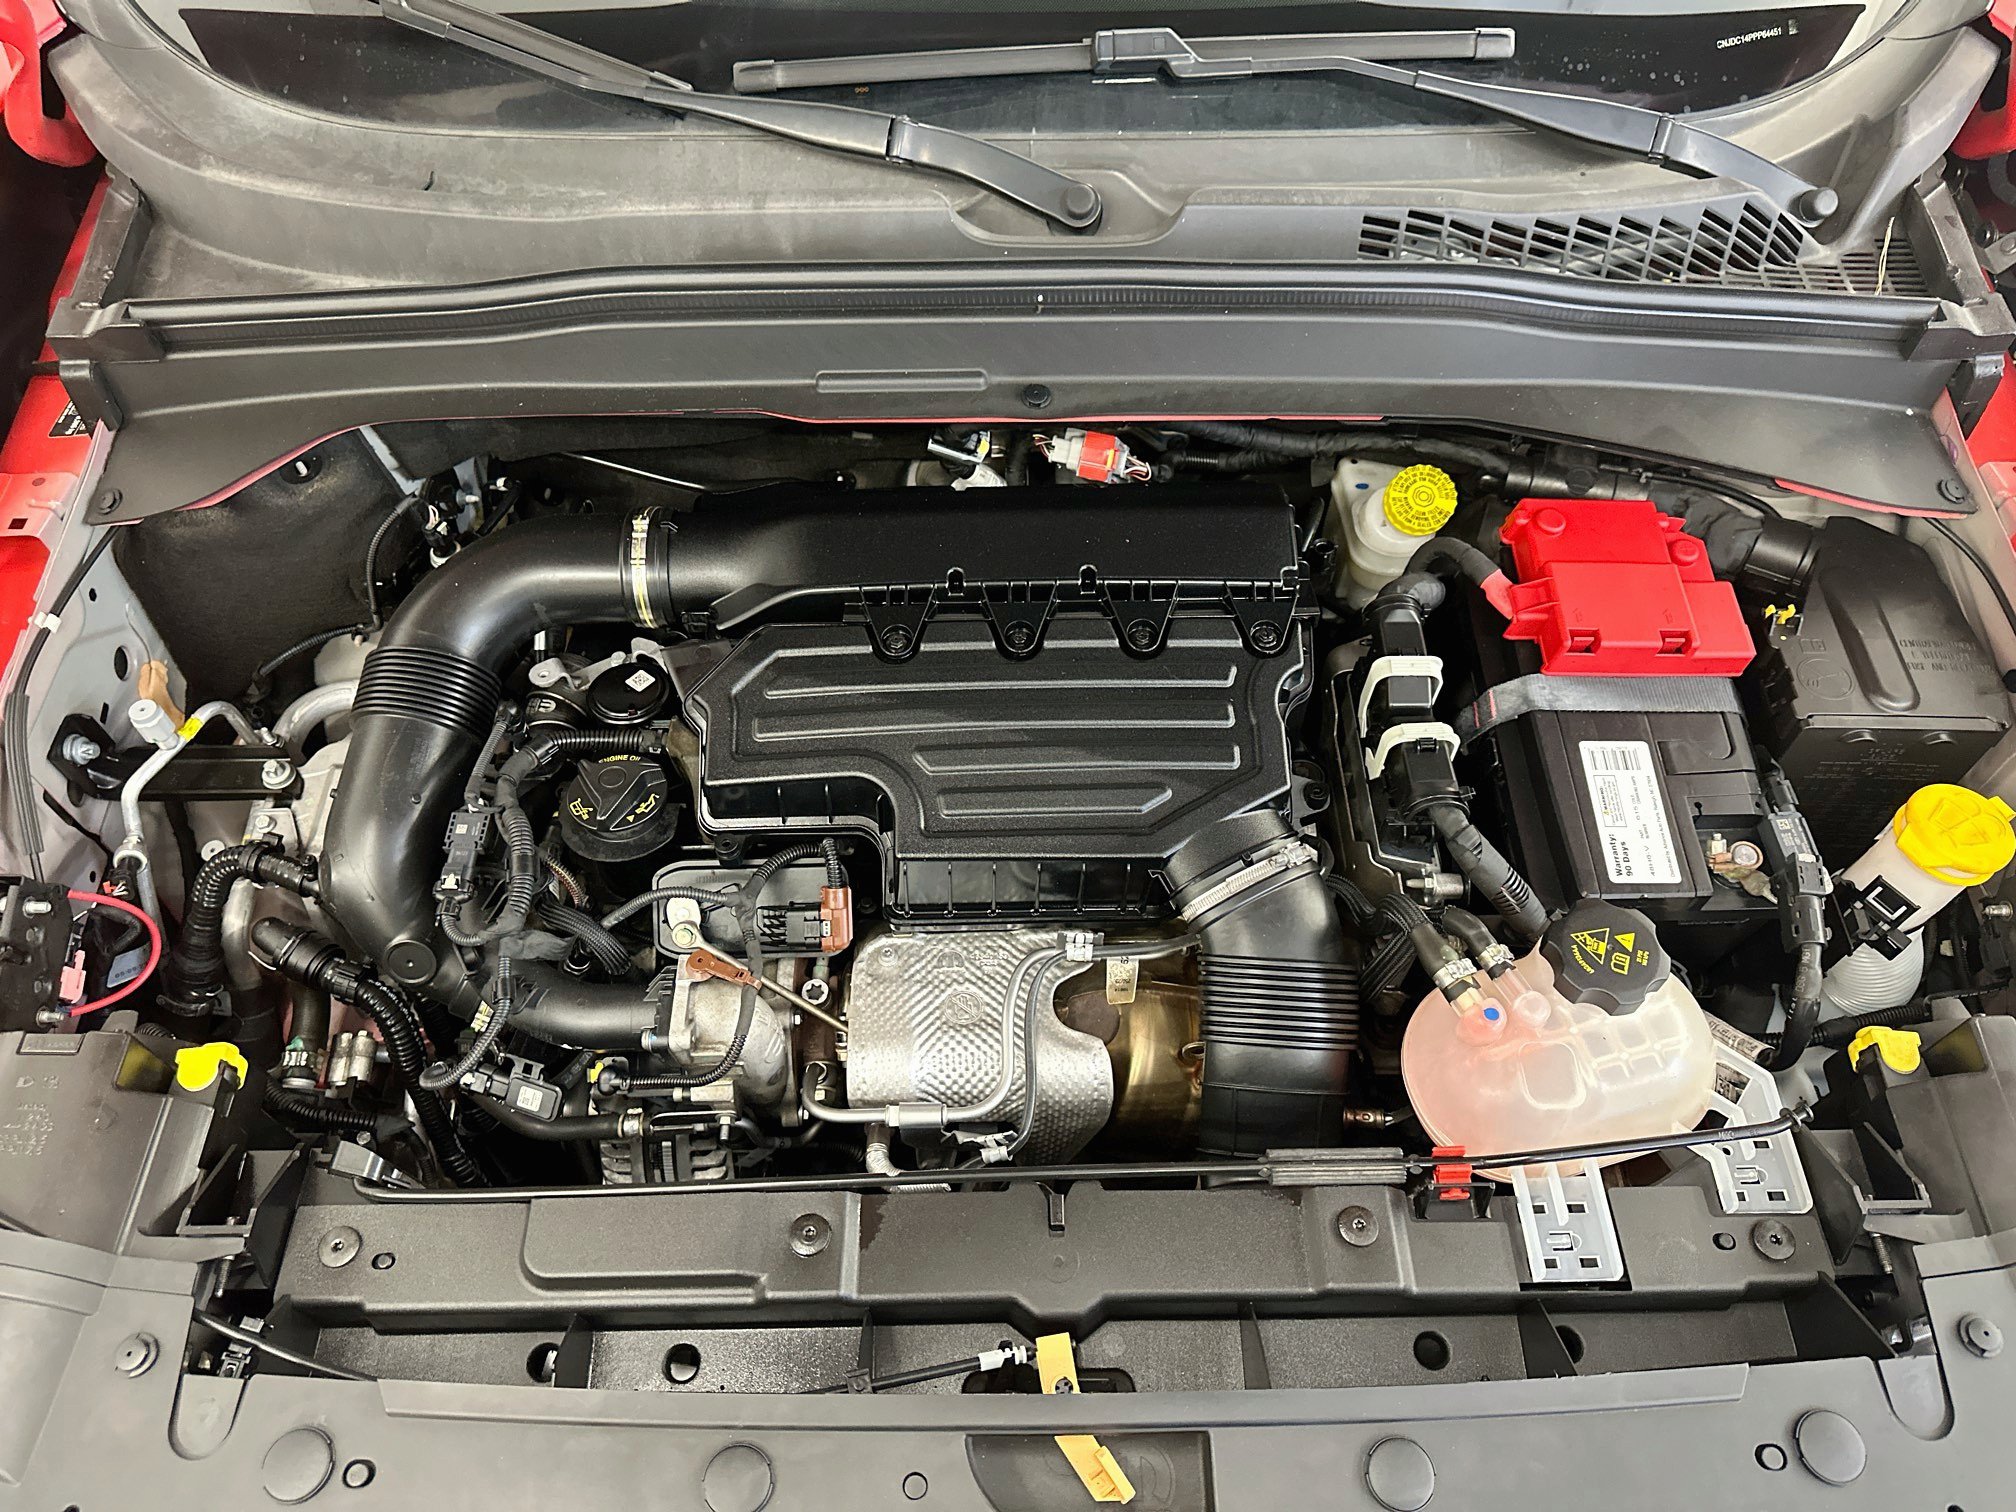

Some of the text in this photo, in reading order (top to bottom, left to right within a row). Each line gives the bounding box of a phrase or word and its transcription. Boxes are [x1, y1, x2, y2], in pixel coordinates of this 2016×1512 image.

[1608, 833, 1623, 876] Warranty:
[1620, 841, 1633, 877] 90 Days
